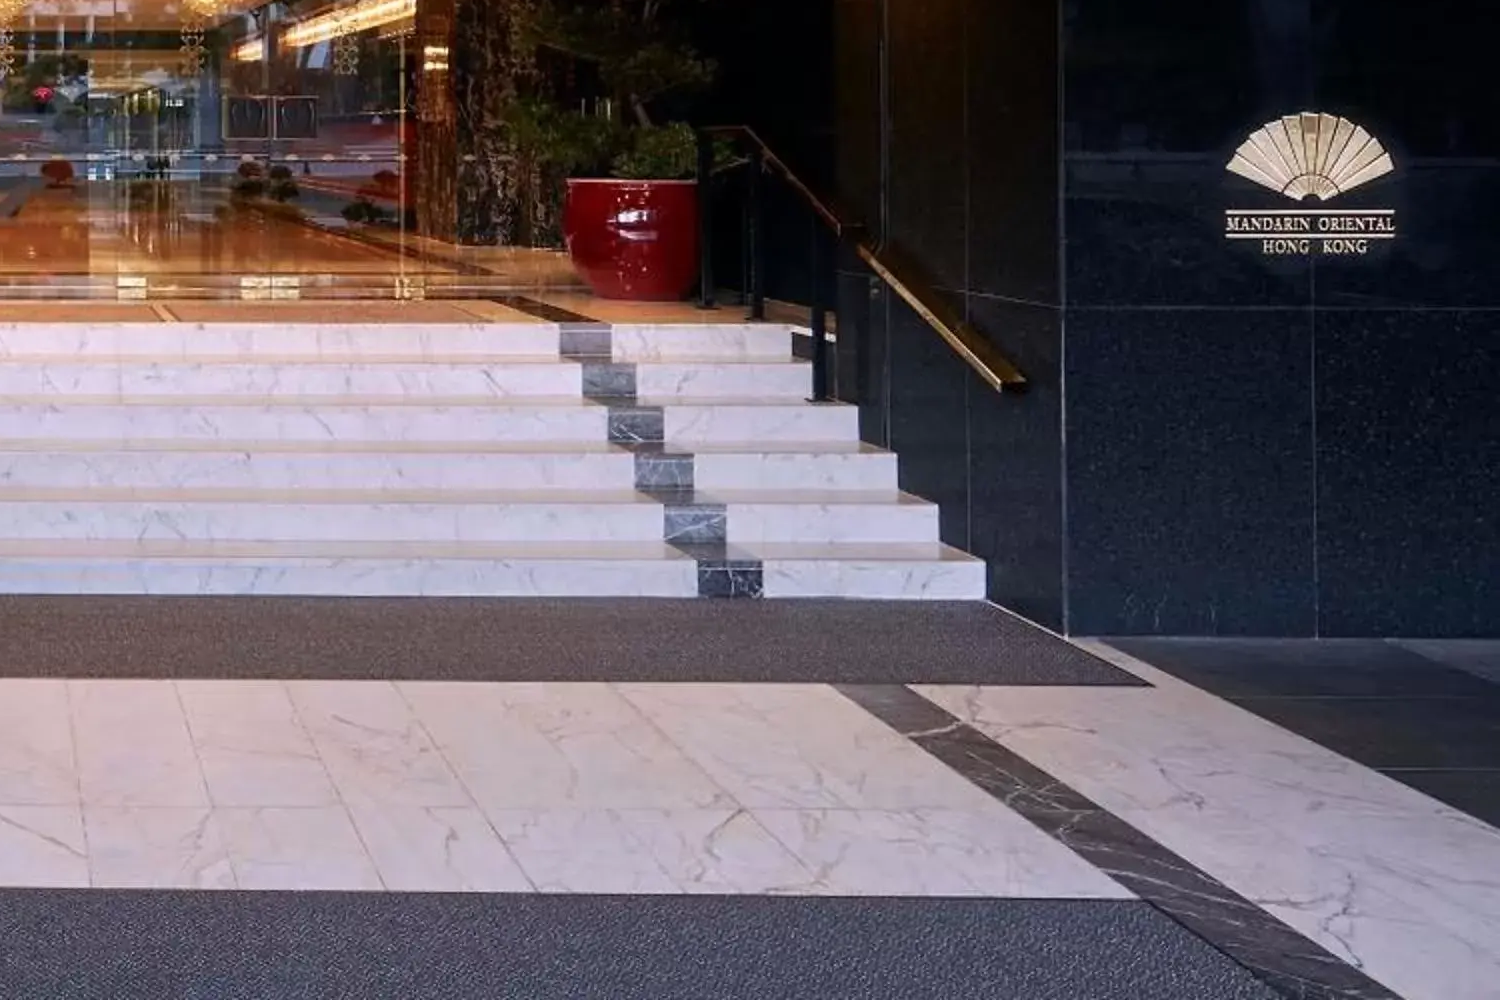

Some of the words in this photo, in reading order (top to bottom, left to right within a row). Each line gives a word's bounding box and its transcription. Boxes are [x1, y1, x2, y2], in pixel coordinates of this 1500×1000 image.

[1226, 217, 1310, 231] MANDARIN
[1318, 217, 1395, 231] ORIENTAL
[1263, 239, 1310, 254] HONG
[1323, 239, 1368, 254] KONG
